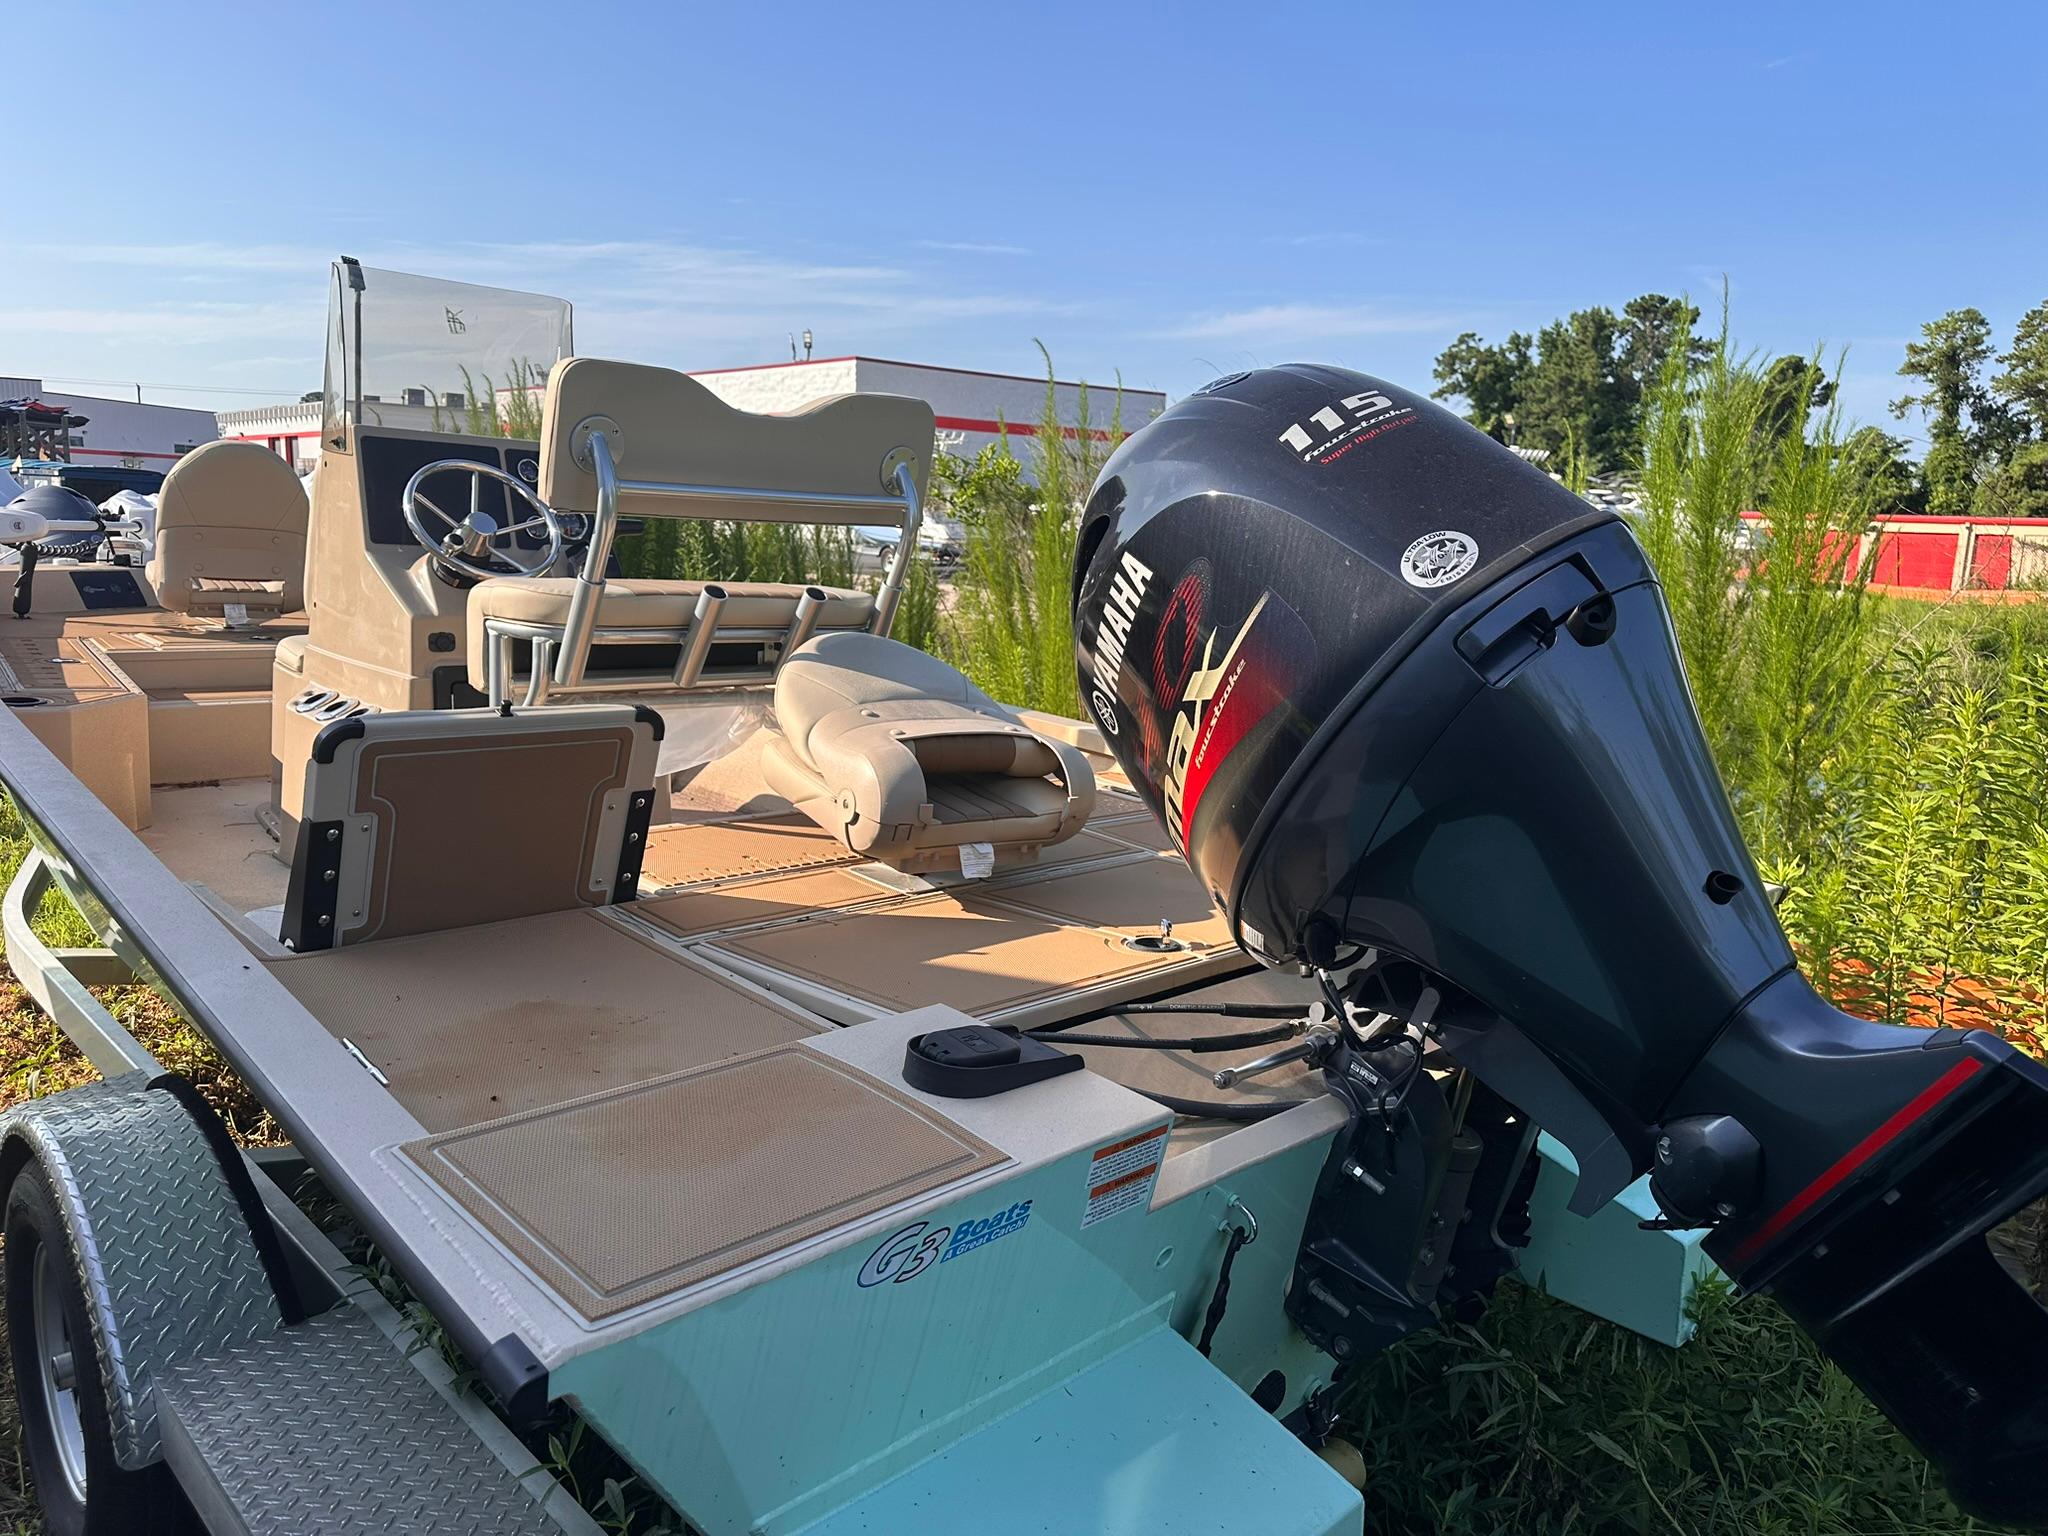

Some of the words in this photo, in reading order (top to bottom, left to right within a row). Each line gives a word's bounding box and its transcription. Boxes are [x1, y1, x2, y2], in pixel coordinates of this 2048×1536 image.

[1278, 390, 1393, 452] 115
[1303, 407, 1412, 462] fourstroke
[1320, 442, 1353, 465] Super
[1354, 429, 1378, 445] High
[1093, 551, 1153, 704] YAMAHA
[1194, 658, 1247, 770] fourstroke
[857, 1221, 951, 1288] G3
[949, 1199, 1033, 1247] Boats
[943, 1250, 953, 1261] A
[956, 1236, 989, 1257] Great
[991, 1217, 1028, 1240] Catch!
